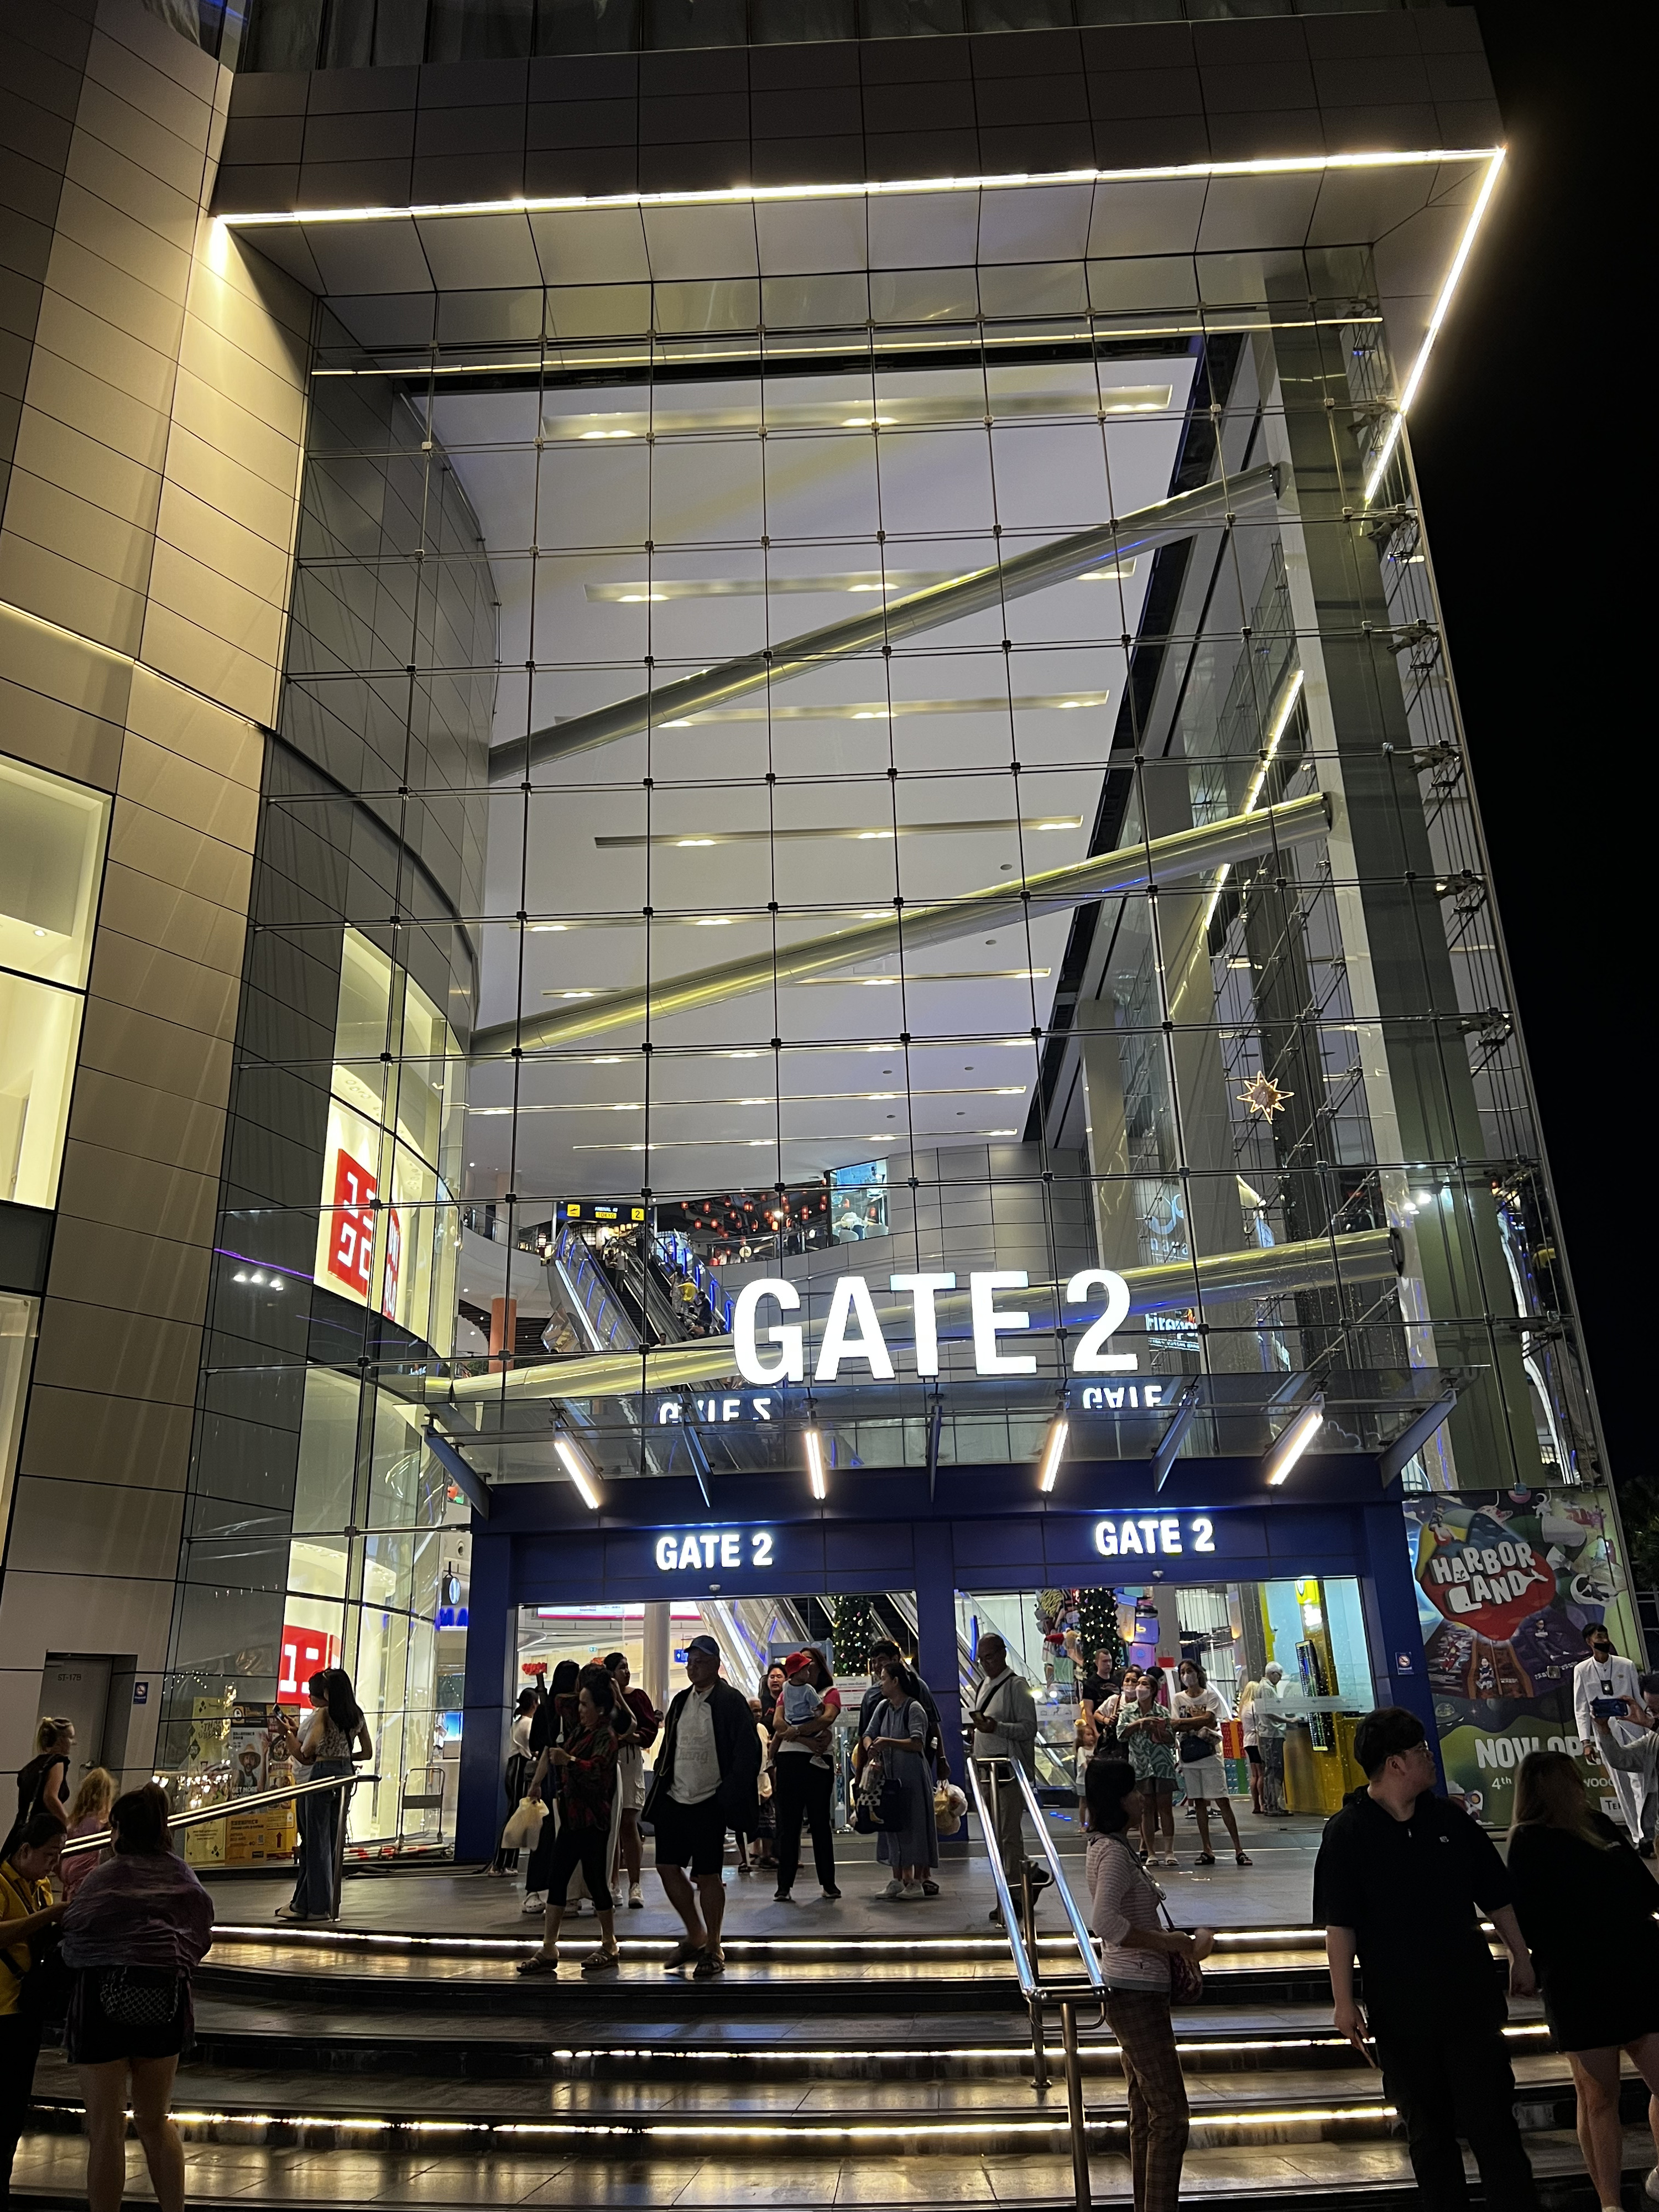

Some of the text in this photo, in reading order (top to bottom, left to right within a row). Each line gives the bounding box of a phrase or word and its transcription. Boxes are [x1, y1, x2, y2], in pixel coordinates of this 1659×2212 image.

[733, 1269, 1139, 1386] GATE 2
[656, 1532, 773, 1571] GATE 2
[1095, 1518, 1215, 1556] GATE 2
[1431, 1541, 1536, 1584] HARBOR
[1448, 1568, 1548, 1614] LAND
[58, 1673, 82, 1682] ST-17B
[1491, 1776, 1512, 1790] 4th
